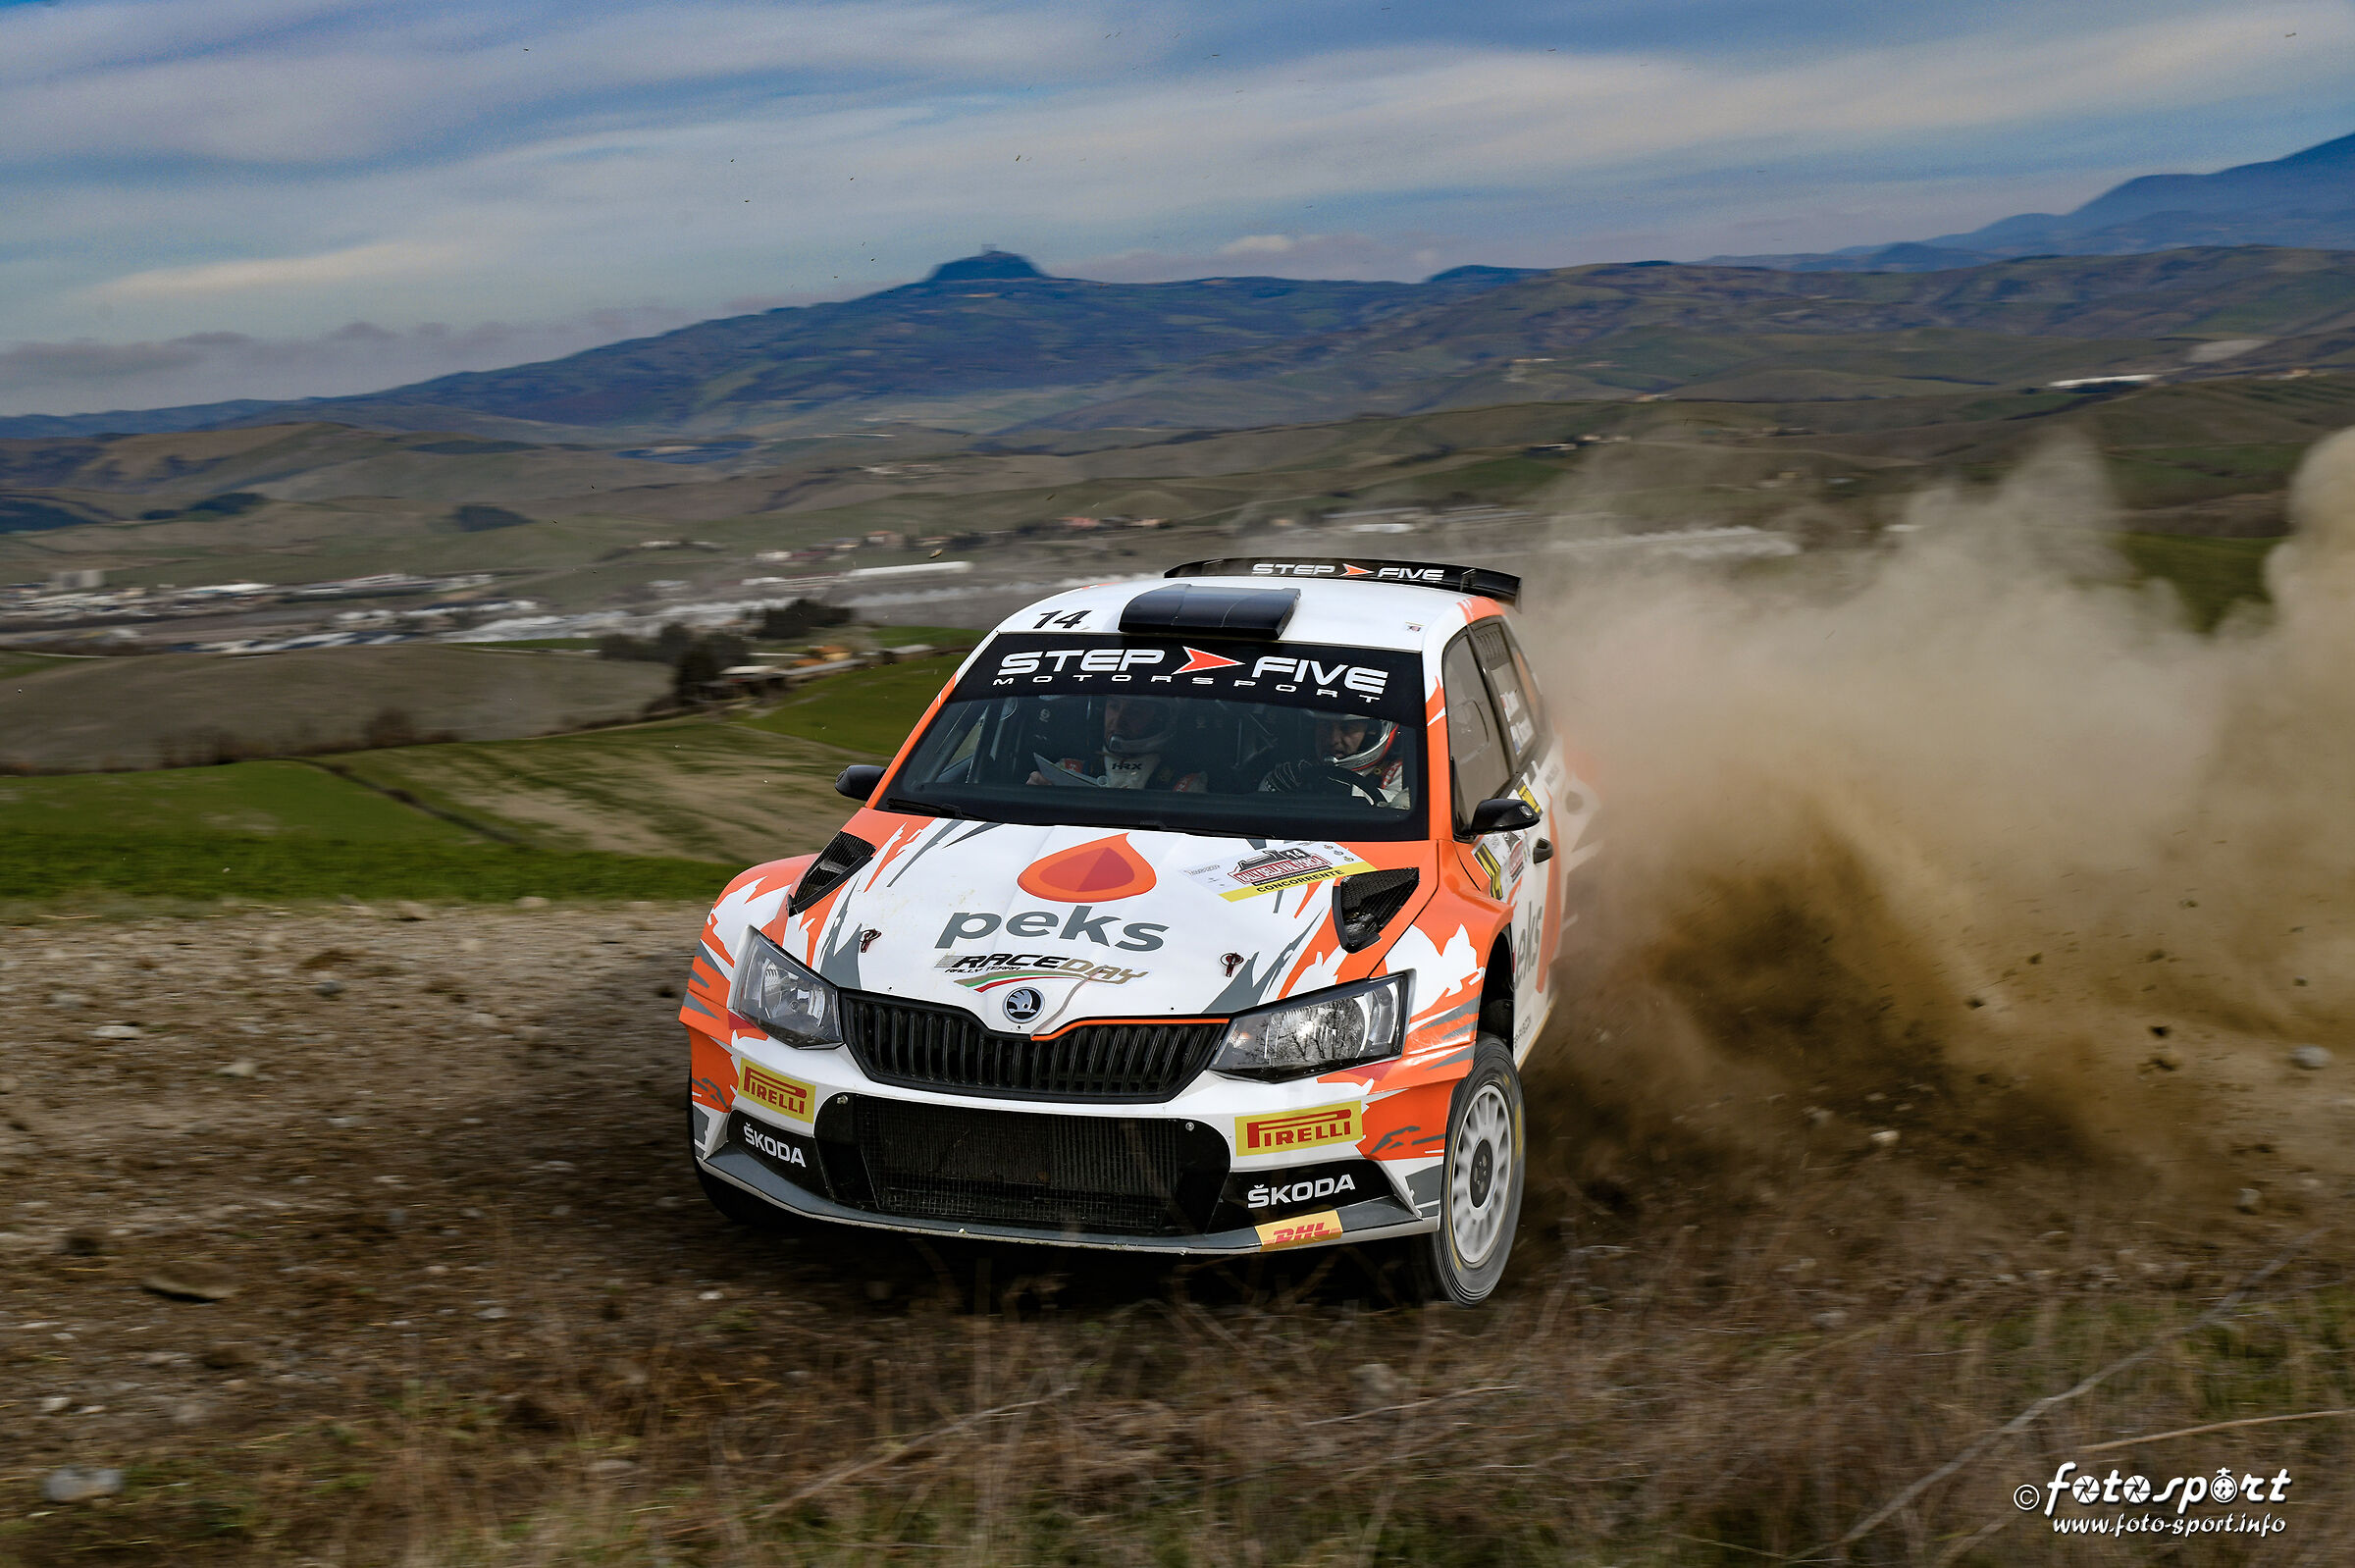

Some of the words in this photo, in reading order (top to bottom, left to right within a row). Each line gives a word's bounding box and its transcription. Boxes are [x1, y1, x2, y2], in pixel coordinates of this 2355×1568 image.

[1251, 563, 1336, 576] STEP
[1377, 566, 1445, 582] FIVE
[1032, 609, 1093, 630] 14
[992, 673, 1381, 704] MOTORSPORT
[997, 649, 1166, 676] STEP
[1251, 655, 1389, 696] FIVE
[1111, 761, 1143, 771] HRX
[1284, 849, 1307, 861] 14
[1256, 869, 1345, 893] CONCORRENTE
[934, 905, 1171, 952] peks
[1514, 900, 1544, 991] eks
[743, 1066, 808, 1116] PIRELLI
[1246, 1108, 1352, 1149] PIRELLI
[743, 1123, 807, 1168] ŠKODA
[1246, 1174, 1356, 1209] ŠKODA
[1273, 1222, 1334, 1243] DHL
